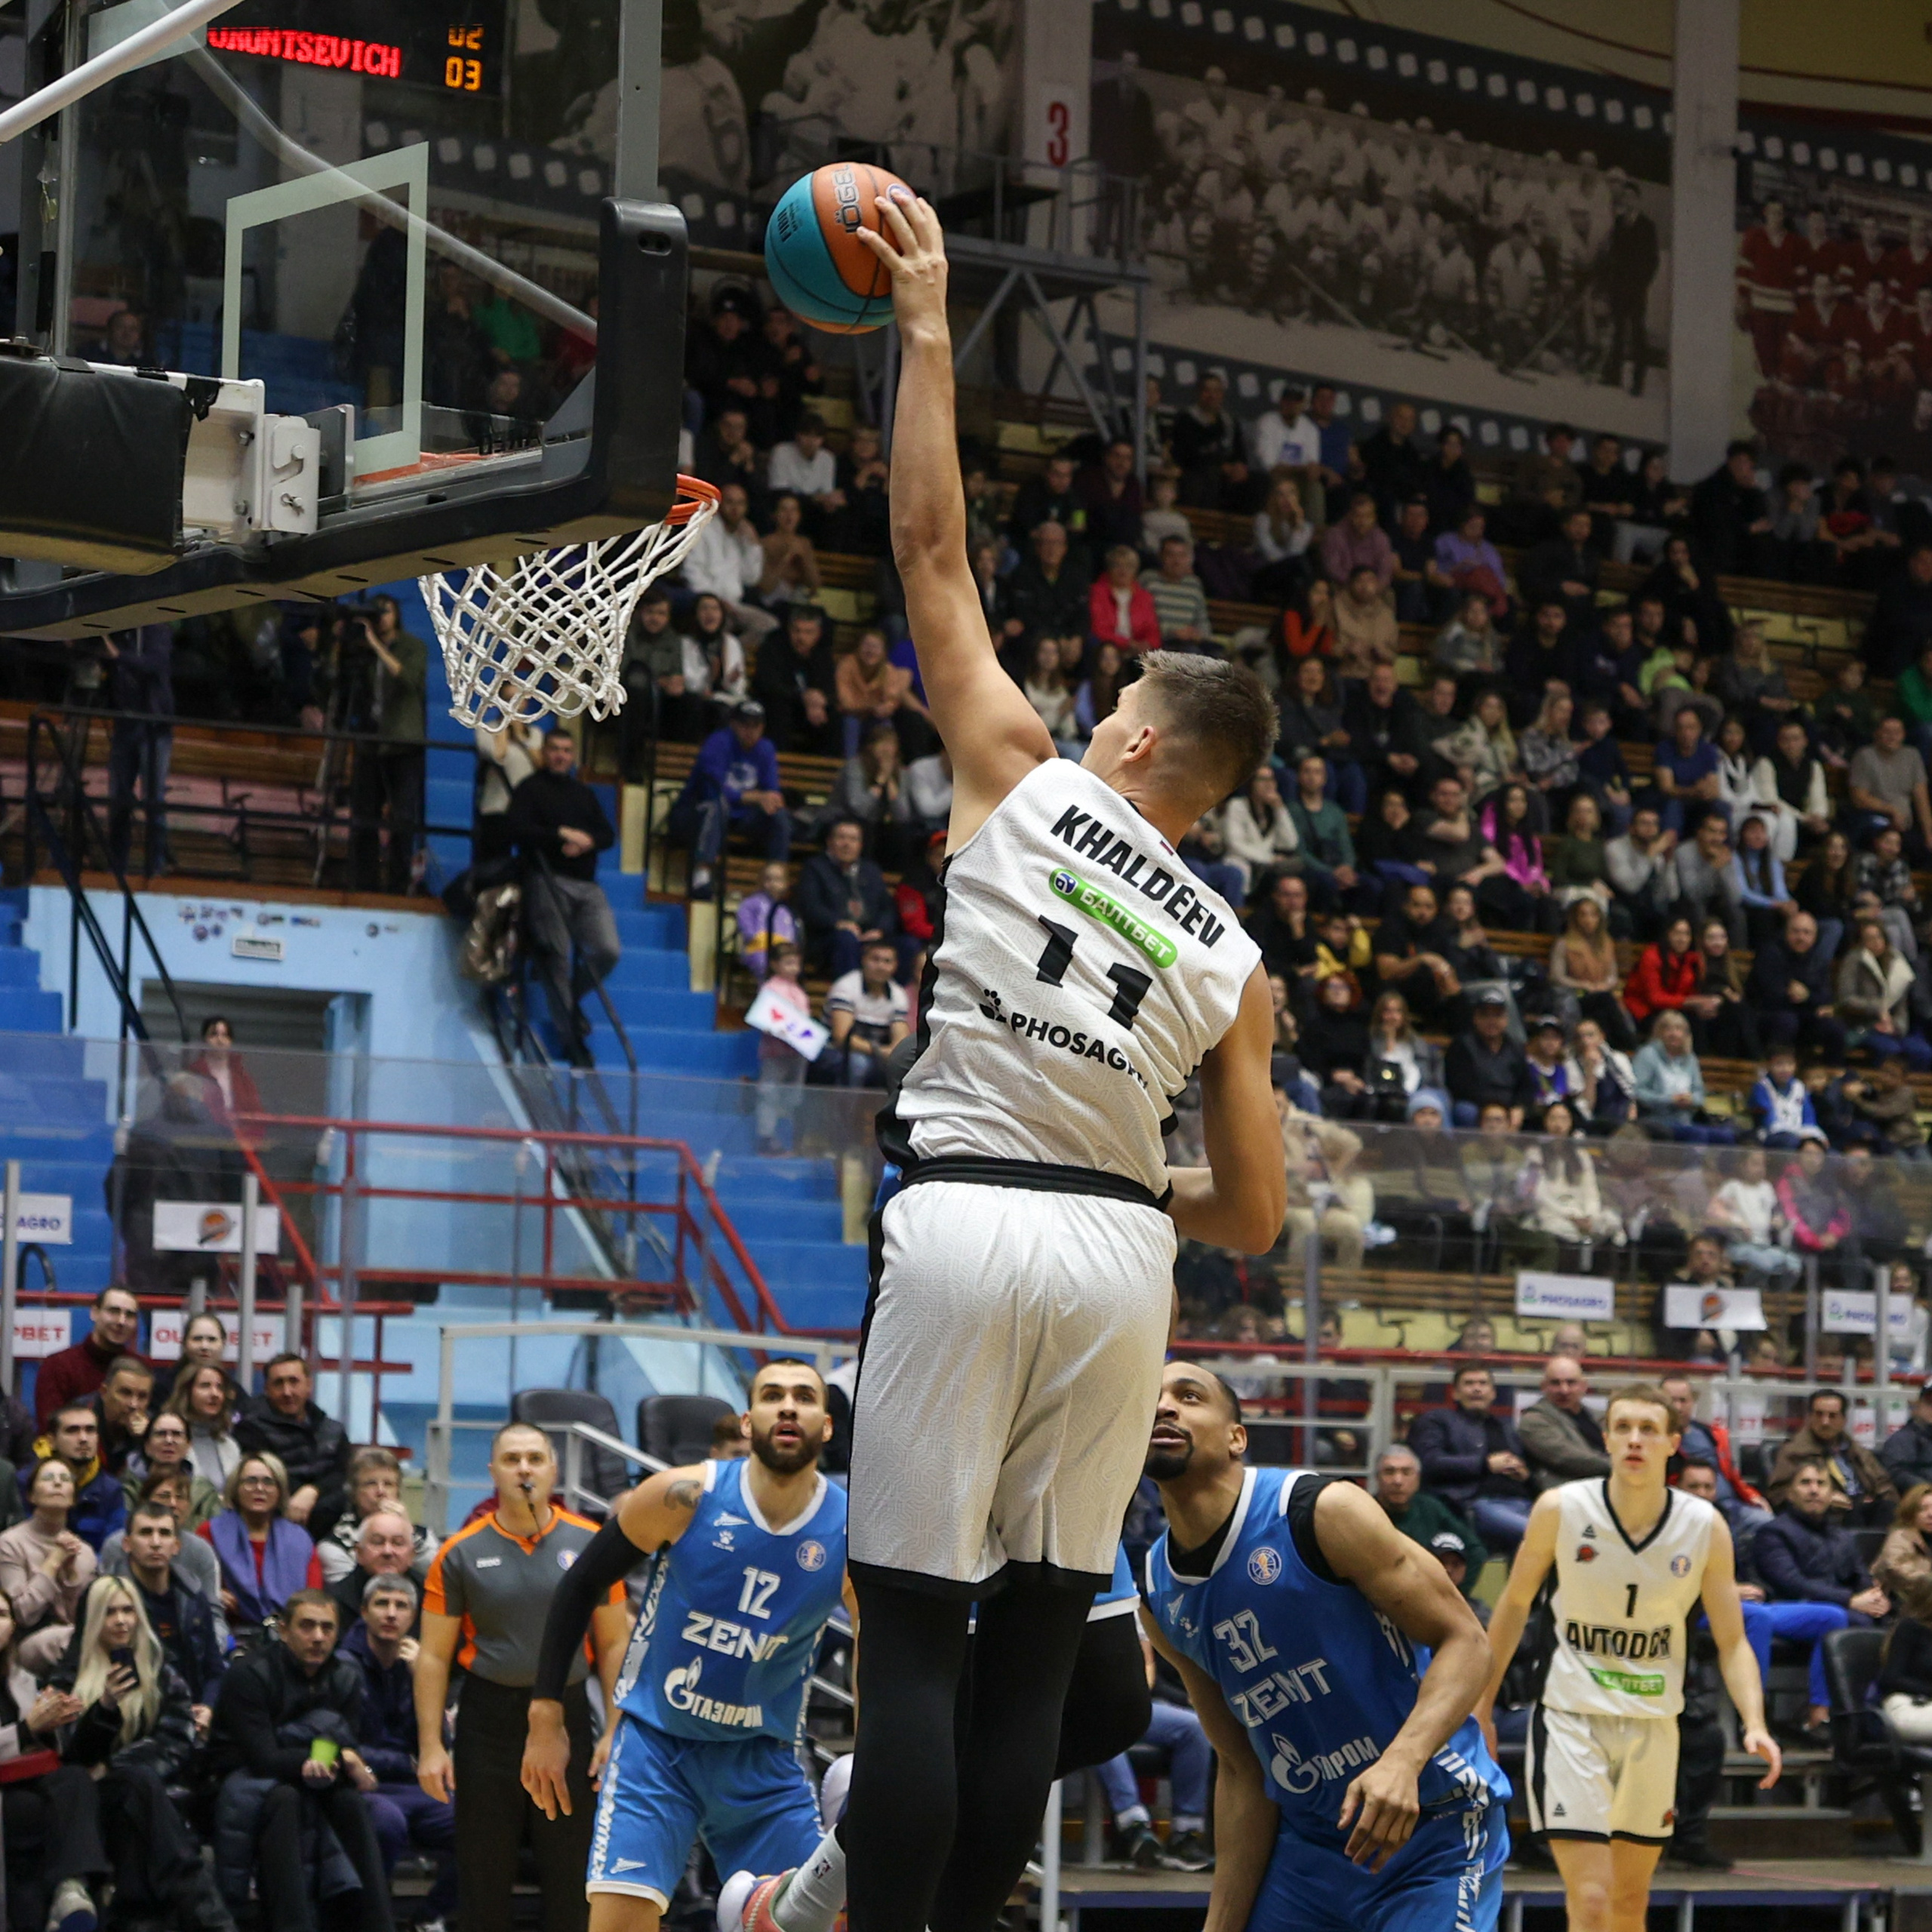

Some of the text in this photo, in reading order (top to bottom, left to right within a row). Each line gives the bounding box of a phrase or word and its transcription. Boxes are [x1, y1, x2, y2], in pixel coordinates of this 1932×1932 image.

[445, 56, 482, 91] 03
[1048, 101, 1069, 167] 3
[1050, 804, 1226, 949] KHALDEEV
[1078, 888, 1172, 960] БАЛТБЕТ
[1036, 915, 1153, 1031] 11
[1011, 1012, 1148, 1090] PHOSAG
[738, 1565, 781, 1620] 12
[1626, 1584, 1639, 1618] 1
[1212, 1609, 1278, 1674] 32
